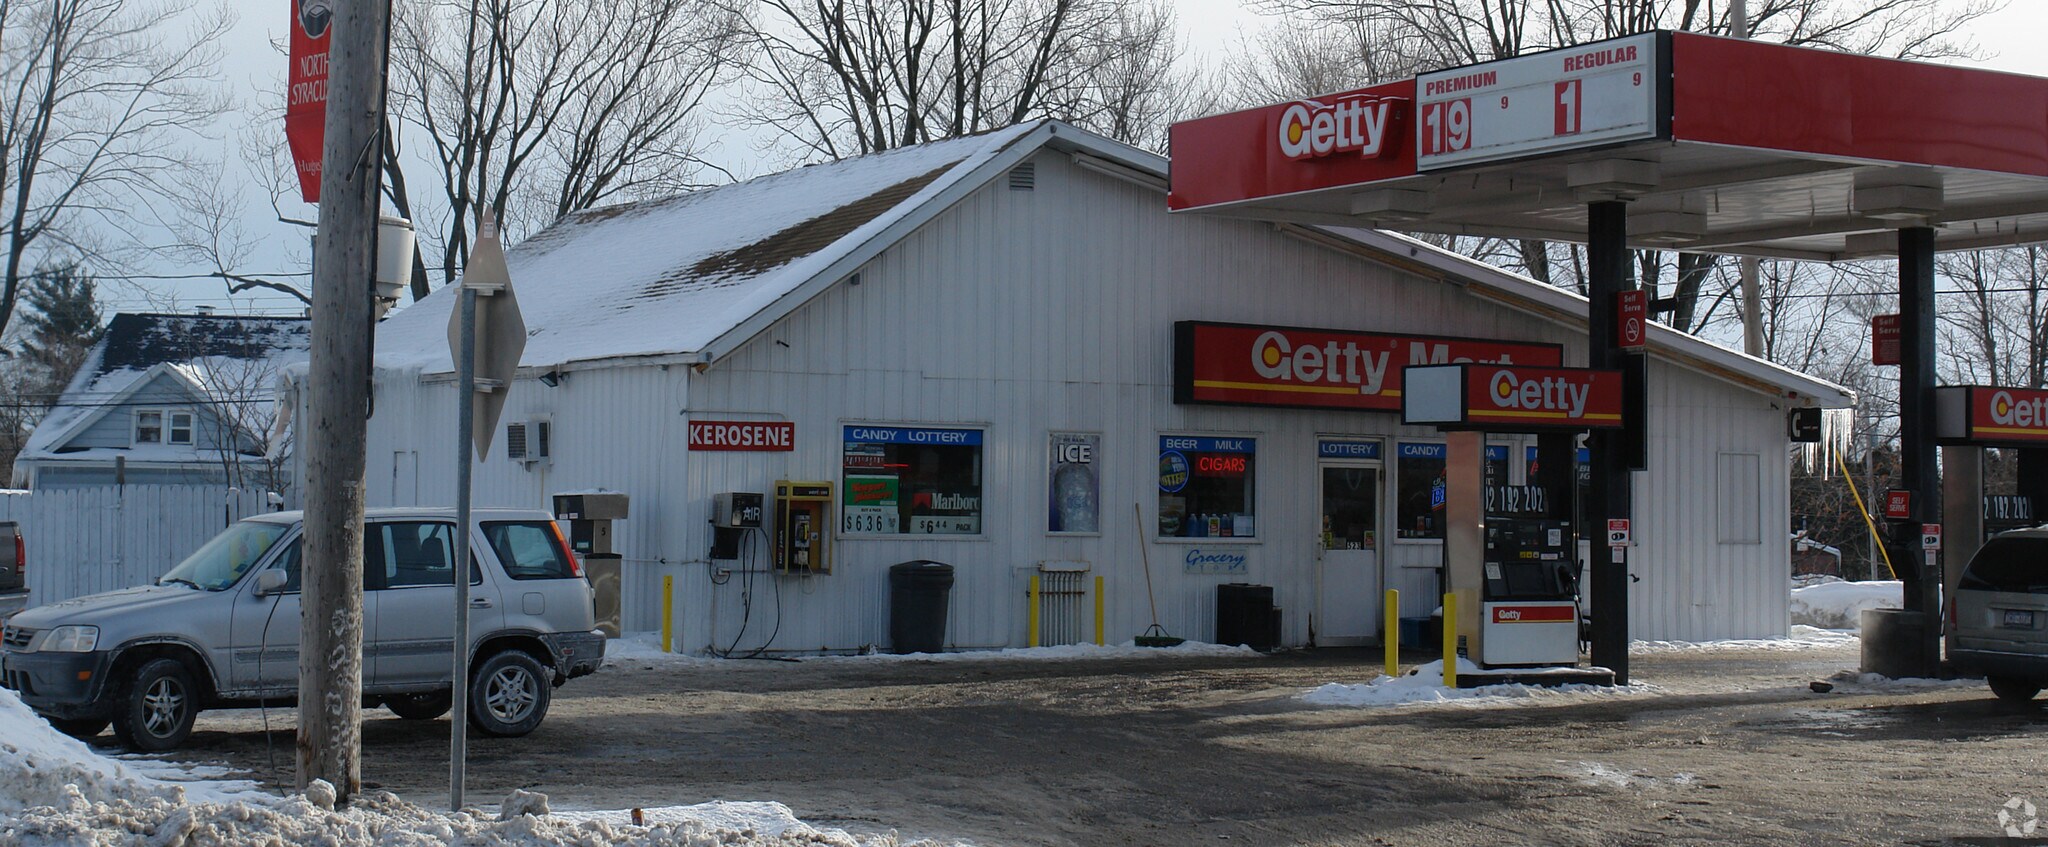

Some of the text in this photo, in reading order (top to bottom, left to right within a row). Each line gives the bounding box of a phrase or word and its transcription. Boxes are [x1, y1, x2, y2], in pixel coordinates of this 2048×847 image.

[1563, 45, 1637, 72] REGULAR
[1425, 70, 1497, 96] PREMIUM
[1560, 72, 1642, 133] 1 9
[1279, 100, 1389, 157] Getty
[1425, 96, 1509, 154] 19 9
[1623, 293, 1637, 303] Self
[1623, 304, 1641, 312] Serve
[1878, 317, 1895, 325] Self
[1251, 331, 1390, 395] Getty
[1489, 369, 1590, 418] Getty
[689, 424, 791, 446] KEROSENE
[852, 428, 968, 443] CANDY LOTTERY
[1165, 438, 1243, 450] BEER MILK
[1322, 443, 1373, 454] LOTTERY
[1404, 445, 1440, 456] CANDY
[1058, 444, 1091, 463] ICE
[1199, 456, 1246, 472] CIGARS
[1500, 485, 1519, 513] 192
[1524, 485, 1543, 513] 202
[1892, 496, 1905, 504] SELF
[742, 506, 760, 521] AIR
[1889, 504, 1907, 512] SERVE
[1993, 495, 2009, 519] 192
[600, 527, 606, 536] 5
[955, 523, 972, 531] PACK
[1185, 549, 1247, 569] Grocery
[1498, 609, 1522, 621] Getty
